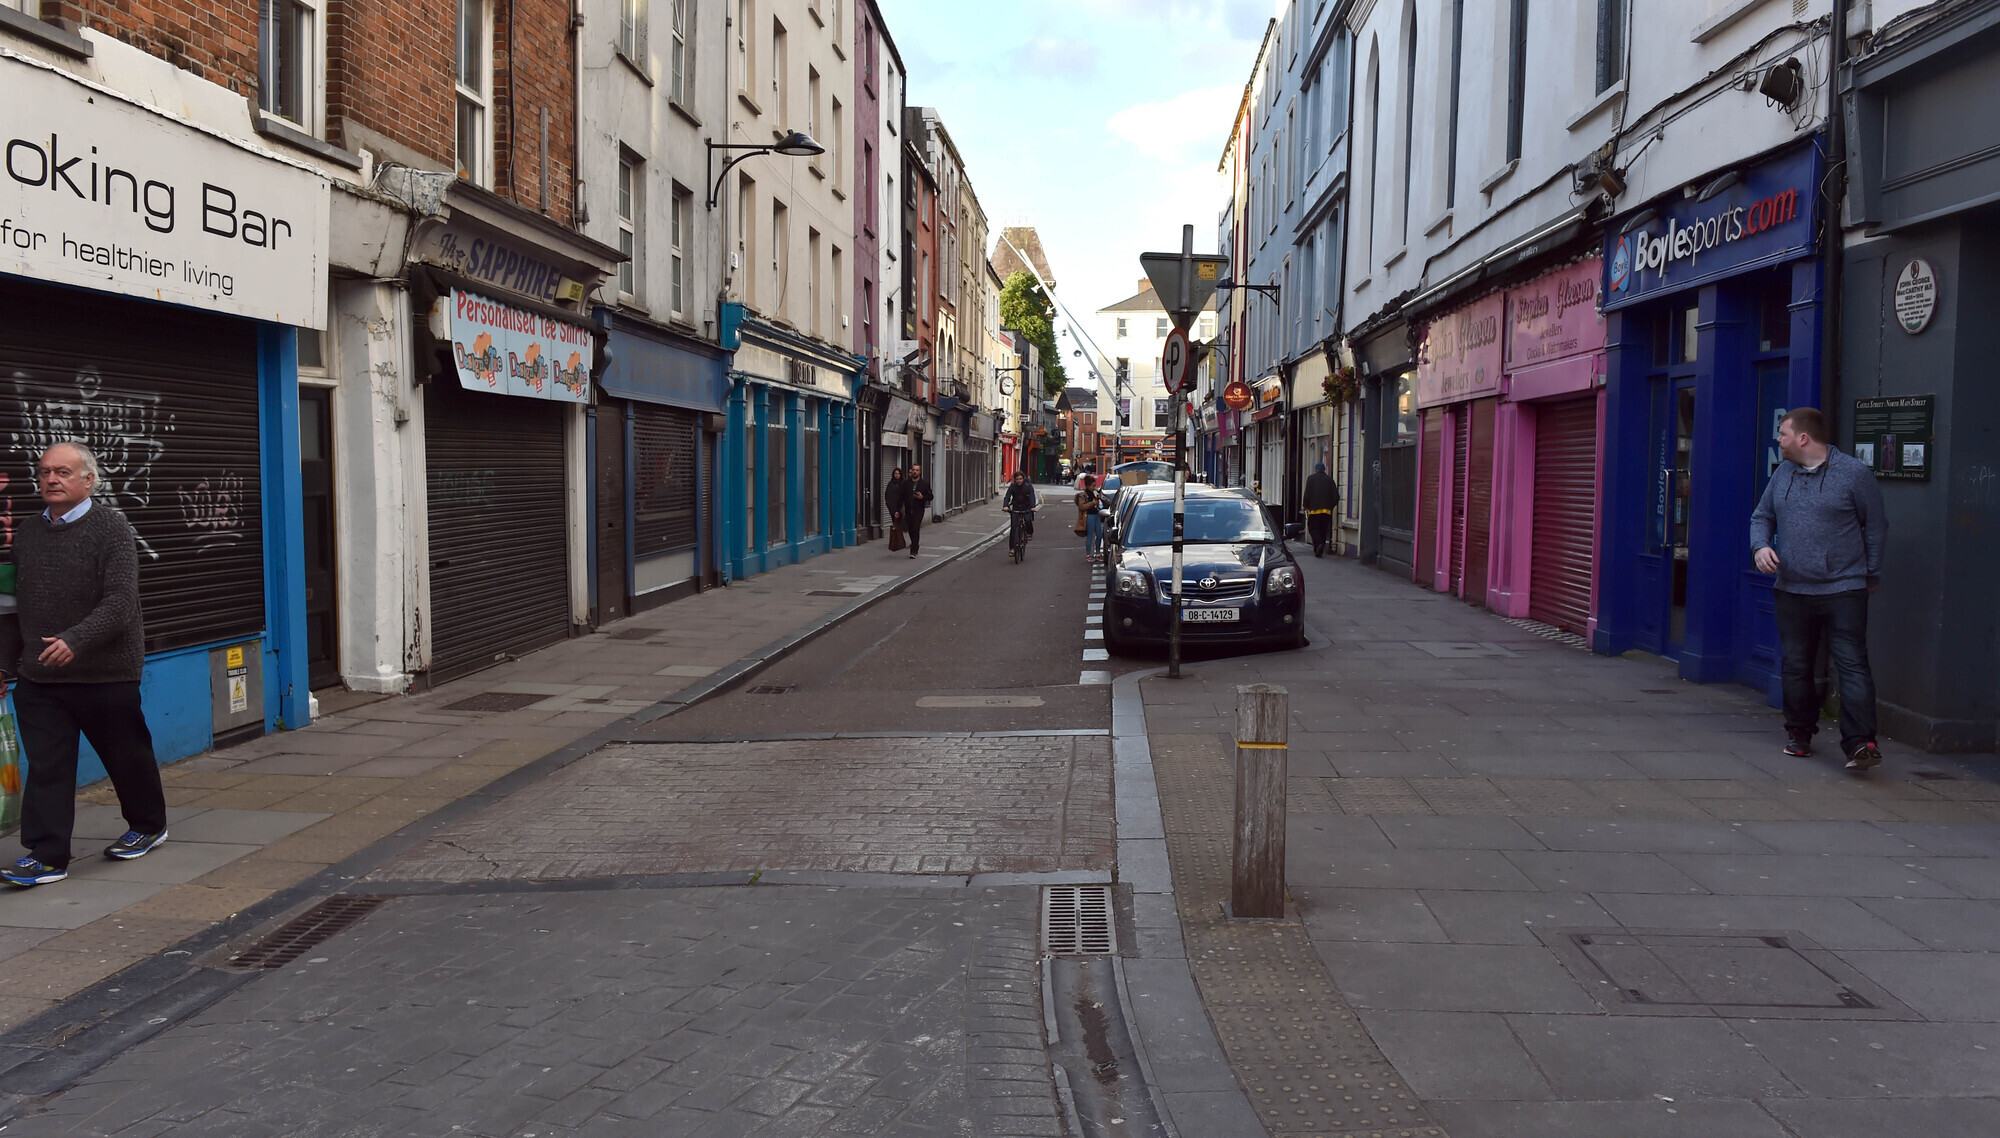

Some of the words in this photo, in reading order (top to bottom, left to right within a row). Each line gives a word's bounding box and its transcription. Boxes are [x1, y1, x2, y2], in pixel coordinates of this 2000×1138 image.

[6, 133, 175, 234] oking
[202, 182, 292, 250] Bar
[1634, 187, 1797, 279] Boylesports.com
[0, 219, 47, 250] for
[62, 232, 175, 278] healthier
[183, 259, 234, 296] living
[440, 233, 466, 267] The
[466, 238, 560, 299] SAPPHIRE
[1613, 260, 1629, 275] Boyle
[1899, 280, 1912, 289] JOHN
[1911, 276, 1930, 286] GEORGE
[457, 292, 536, 335] Personalised
[539, 316, 556, 341] Tee
[559, 320, 588, 347] Shirts
[1516, 288, 1549, 329] Stephen
[1556, 278, 1594, 319] Gleeson
[1458, 313, 1496, 364] Gleeson
[1540, 323, 1563, 340] Jewellers
[455, 342, 485, 380] Design
[508, 352, 534, 387] Design
[1171, 341, 1180, 379] P
[1441, 368, 1470, 394] Jewellers
[1188, 610, 1233, 621] 08-C-14129
